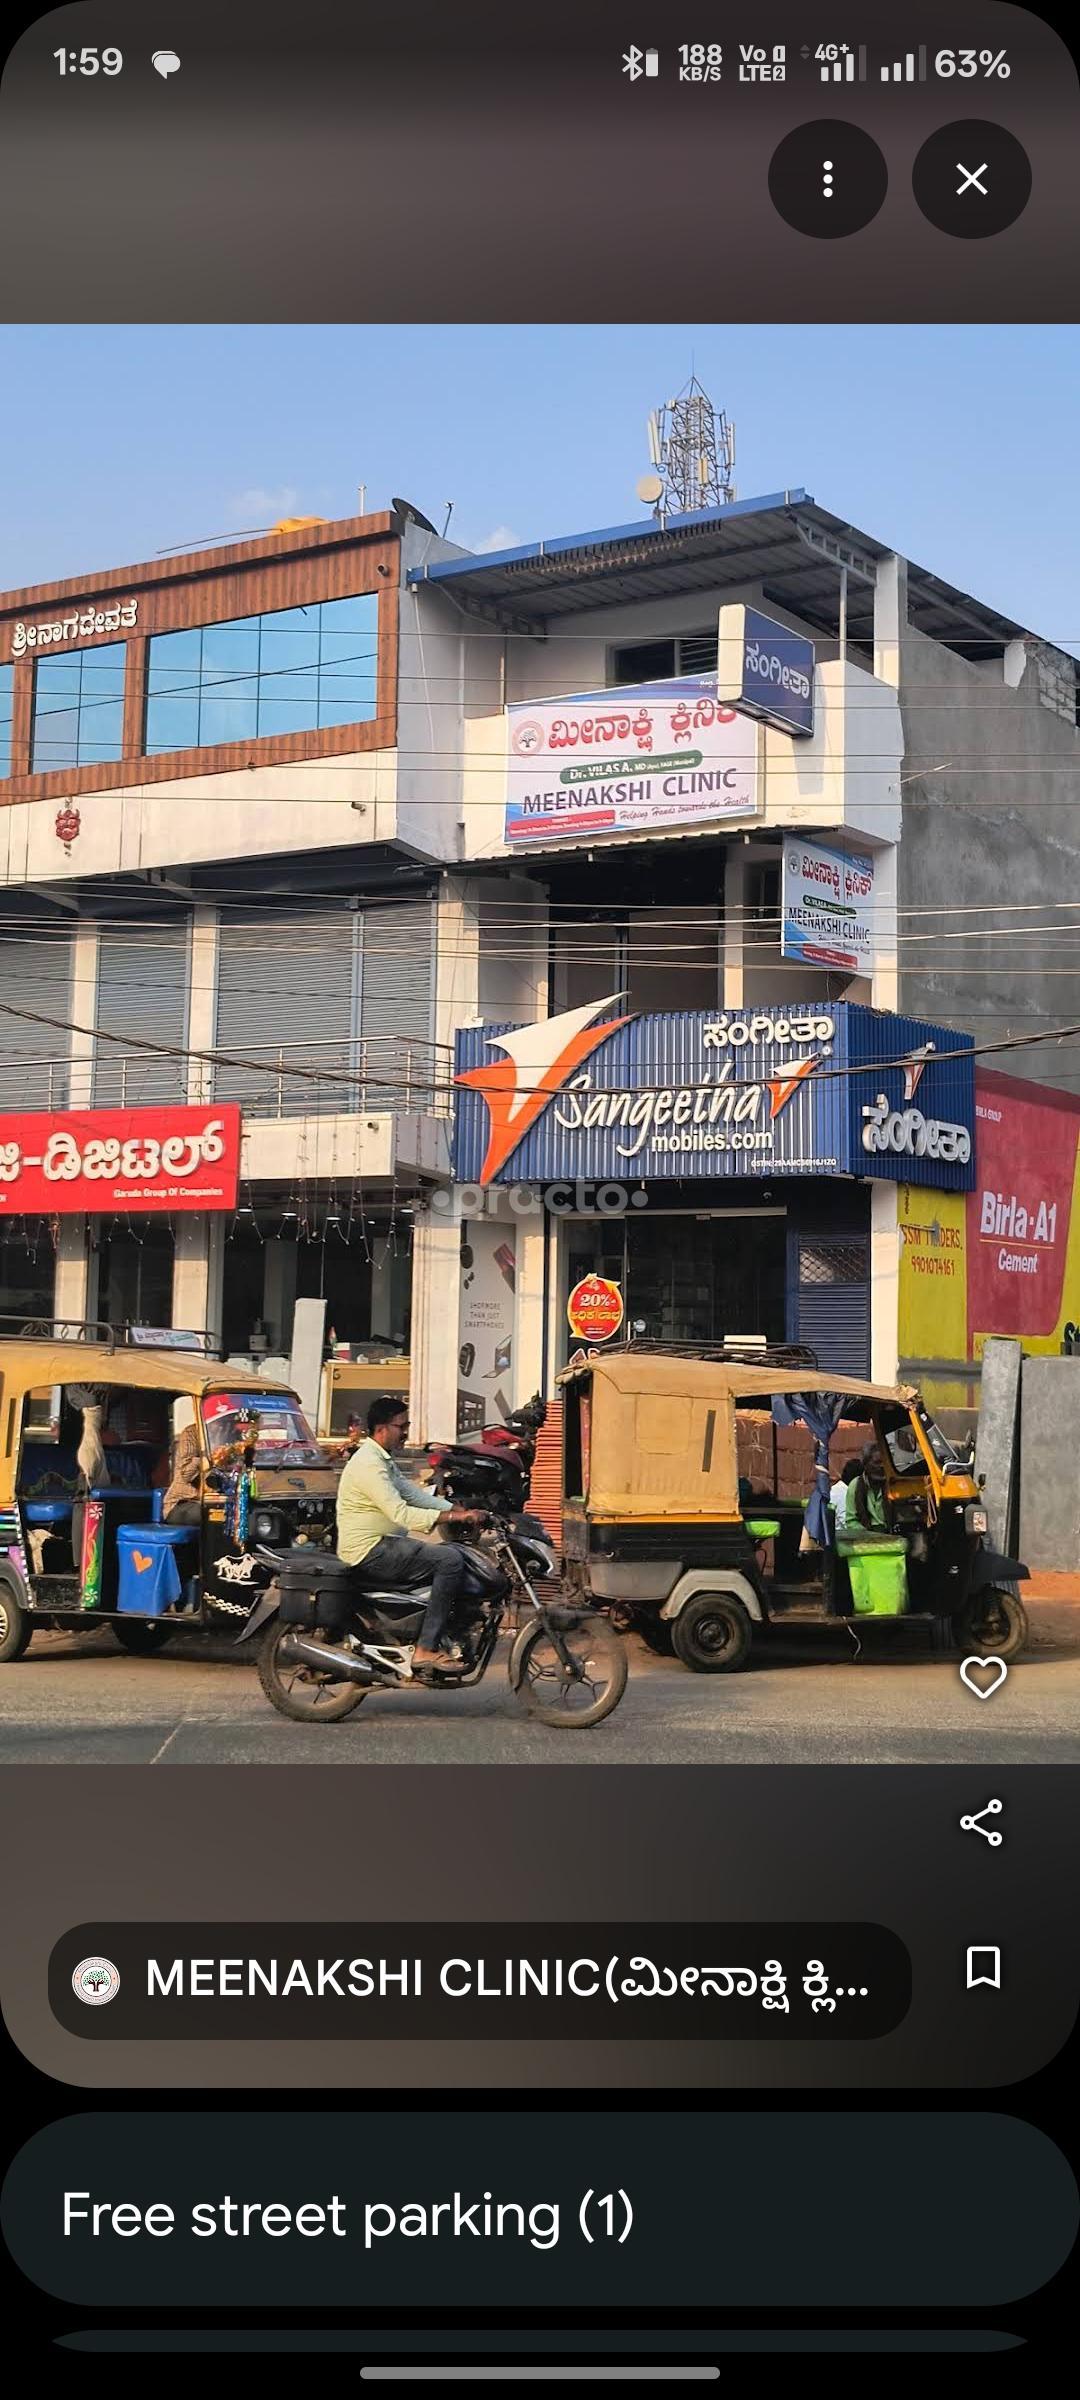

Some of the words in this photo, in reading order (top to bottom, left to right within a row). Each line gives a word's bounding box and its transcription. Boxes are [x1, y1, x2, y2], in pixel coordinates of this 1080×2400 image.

[11, 599, 138, 657] ಶ್ರೀನಾಗದೇವತೆ
[745, 643, 810, 700] ಸಂಗೀತಾ
[548, 708, 654, 752] ಮೀನಾಕ್ಷಿ
[523, 780, 651, 814] MEENAKSHI
[662, 767, 737, 797] CLINIC
[569, 769, 587, 780] Dr.
[588, 762, 620, 777] VILAS
[788, 906, 841, 936] MEENAKSHI
[842, 921, 870, 945] CLINIC
[703, 1013, 834, 1049] ಸಂಗೀತಾ
[554, 1059, 763, 1157] Sangeetha
[862, 1093, 971, 1164] ಸಂಗೀತಾ
[651, 1129, 773, 1153] mobiles.com
[925, 1226, 963, 1250] TDERS.
[998, 1248, 1038, 1273] Cement
